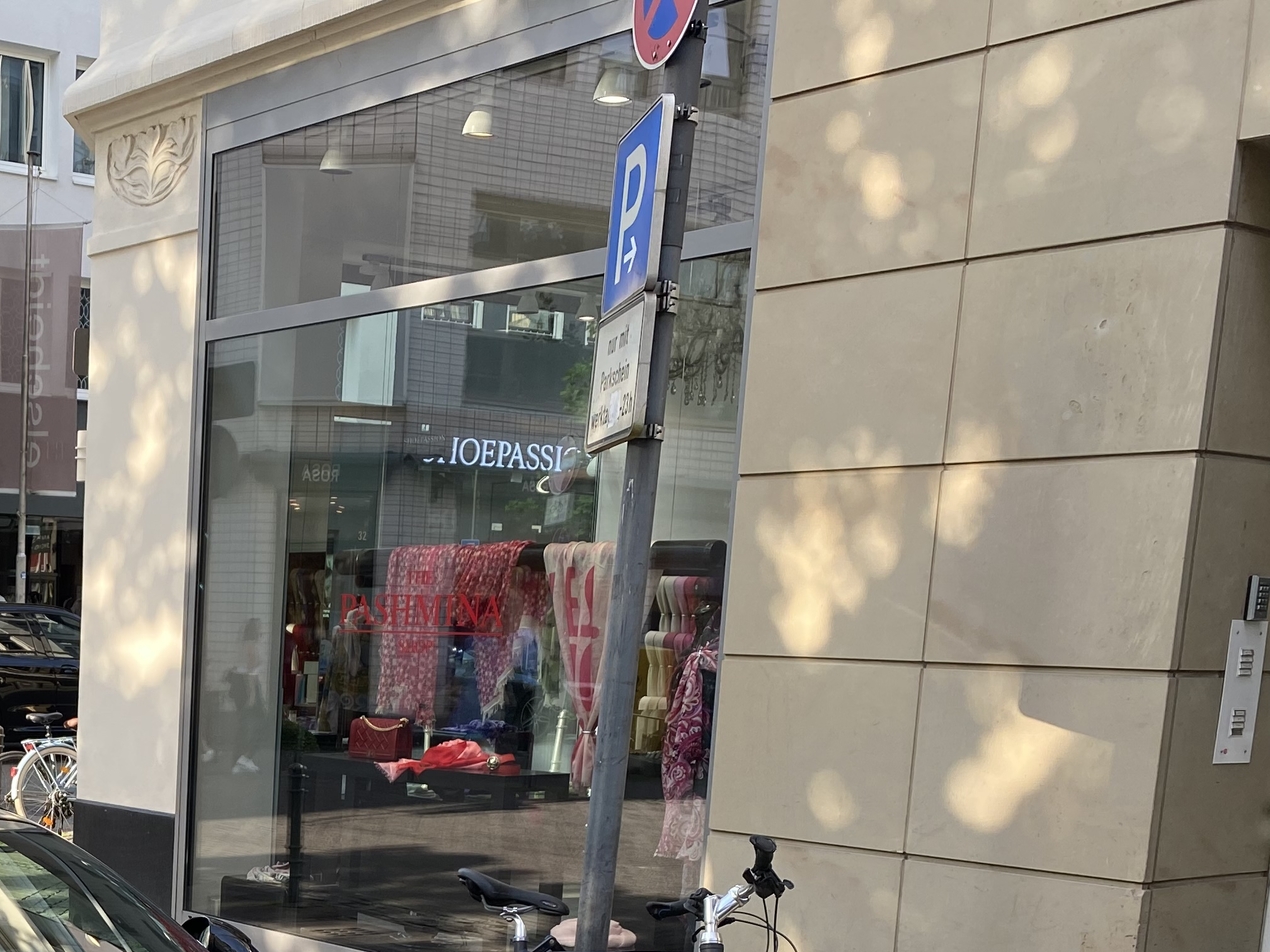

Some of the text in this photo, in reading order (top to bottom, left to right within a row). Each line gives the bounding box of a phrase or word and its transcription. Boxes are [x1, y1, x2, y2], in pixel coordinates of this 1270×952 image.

[614, 143, 647, 285] P
[600, 357, 630, 392] Parkschein
[357, 531, 367, 541] 32
[339, 593, 503, 628] PASHMINA
